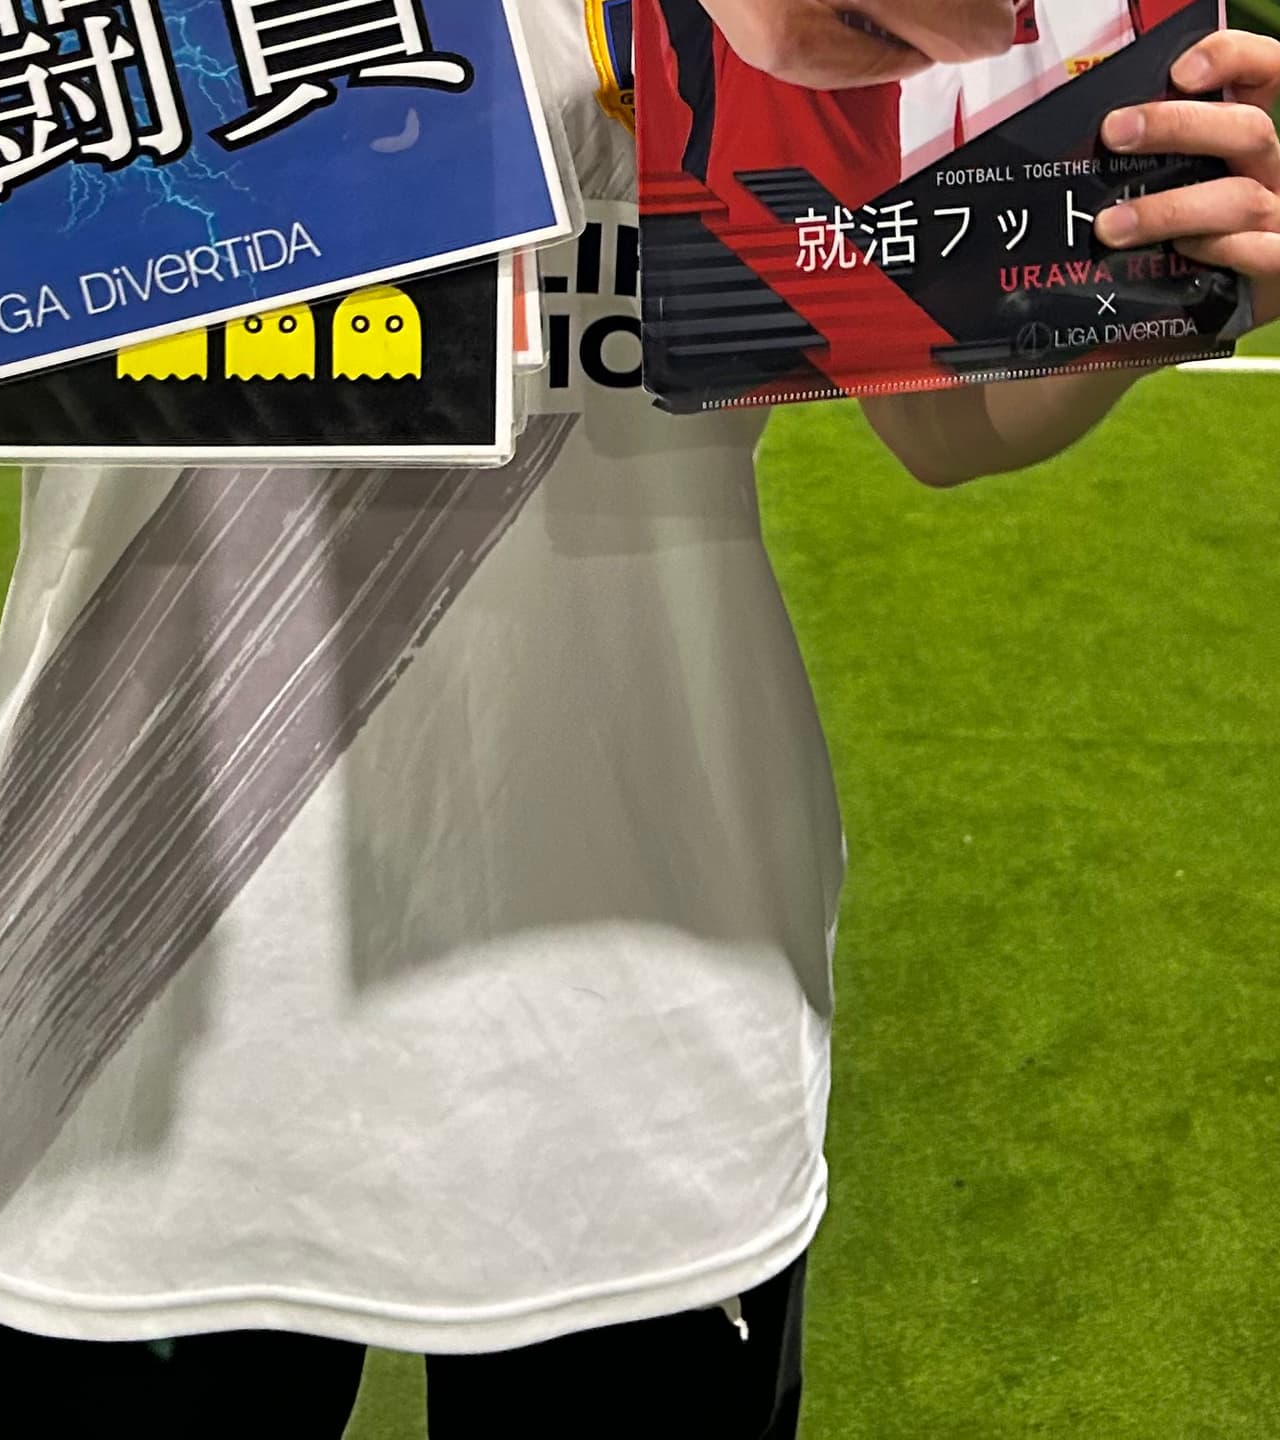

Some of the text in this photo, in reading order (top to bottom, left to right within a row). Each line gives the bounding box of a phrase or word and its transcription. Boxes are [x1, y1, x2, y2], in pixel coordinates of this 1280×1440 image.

[936, 163, 1015, 187] FOOTBALL
[1023, 159, 1102, 180] TOGETHER
[794, 183, 1200, 273] 就活フット
[1000, 259, 1114, 292] URAWA
